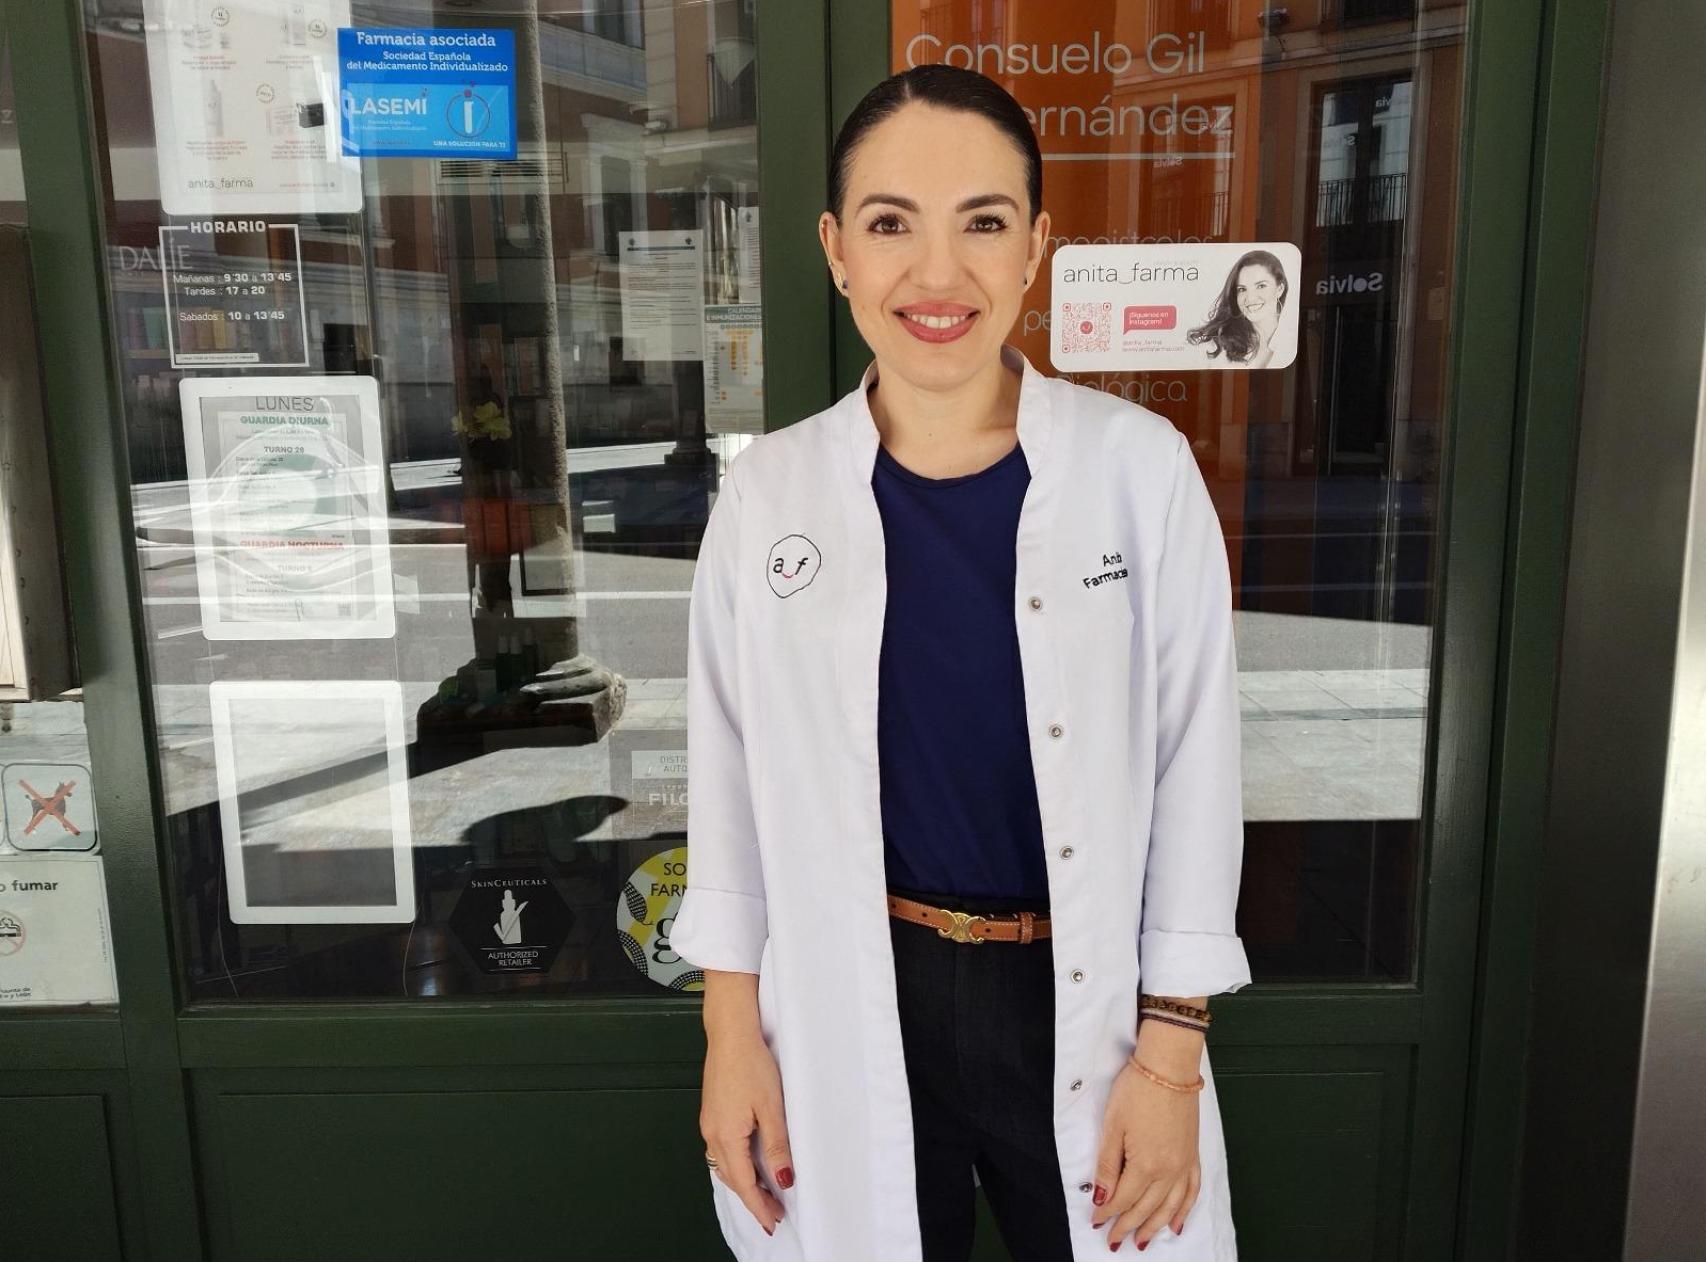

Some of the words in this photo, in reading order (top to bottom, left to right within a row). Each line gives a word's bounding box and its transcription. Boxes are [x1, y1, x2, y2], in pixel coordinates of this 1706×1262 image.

[357, 32, 425, 46] Farmacia
[429, 33, 497, 47] asociada
[383, 51, 426, 61] Sociedad
[428, 51, 472, 63] Española
[905, 31, 1132, 75] Consuelo
[1147, 31, 1205, 74] Gil
[346, 60, 362, 70] del
[363, 61, 428, 71] Medicamento
[429, 61, 508, 72] Individualizado
[1021, 93, 1233, 136] ernández
[190, 220, 266, 234] HORARIO
[173, 273, 215, 284] Mañanas
[1063, 262, 1199, 285] anita_farma
[184, 286, 216, 296] Tardes
[225, 286, 239, 296] 17
[251, 285, 266, 295] 20
[227, 311, 242, 321] 10
[256, 396, 314, 411] LUNES
[240, 415, 286, 425] GUARDIA
[288, 415, 329, 426] DIURNA
[264, 446, 293, 454] TURNO
[12, 880, 59, 891] fumar
[488, 950, 539, 960] AUTHORIZED
[498, 958, 533, 967] RETAILER
